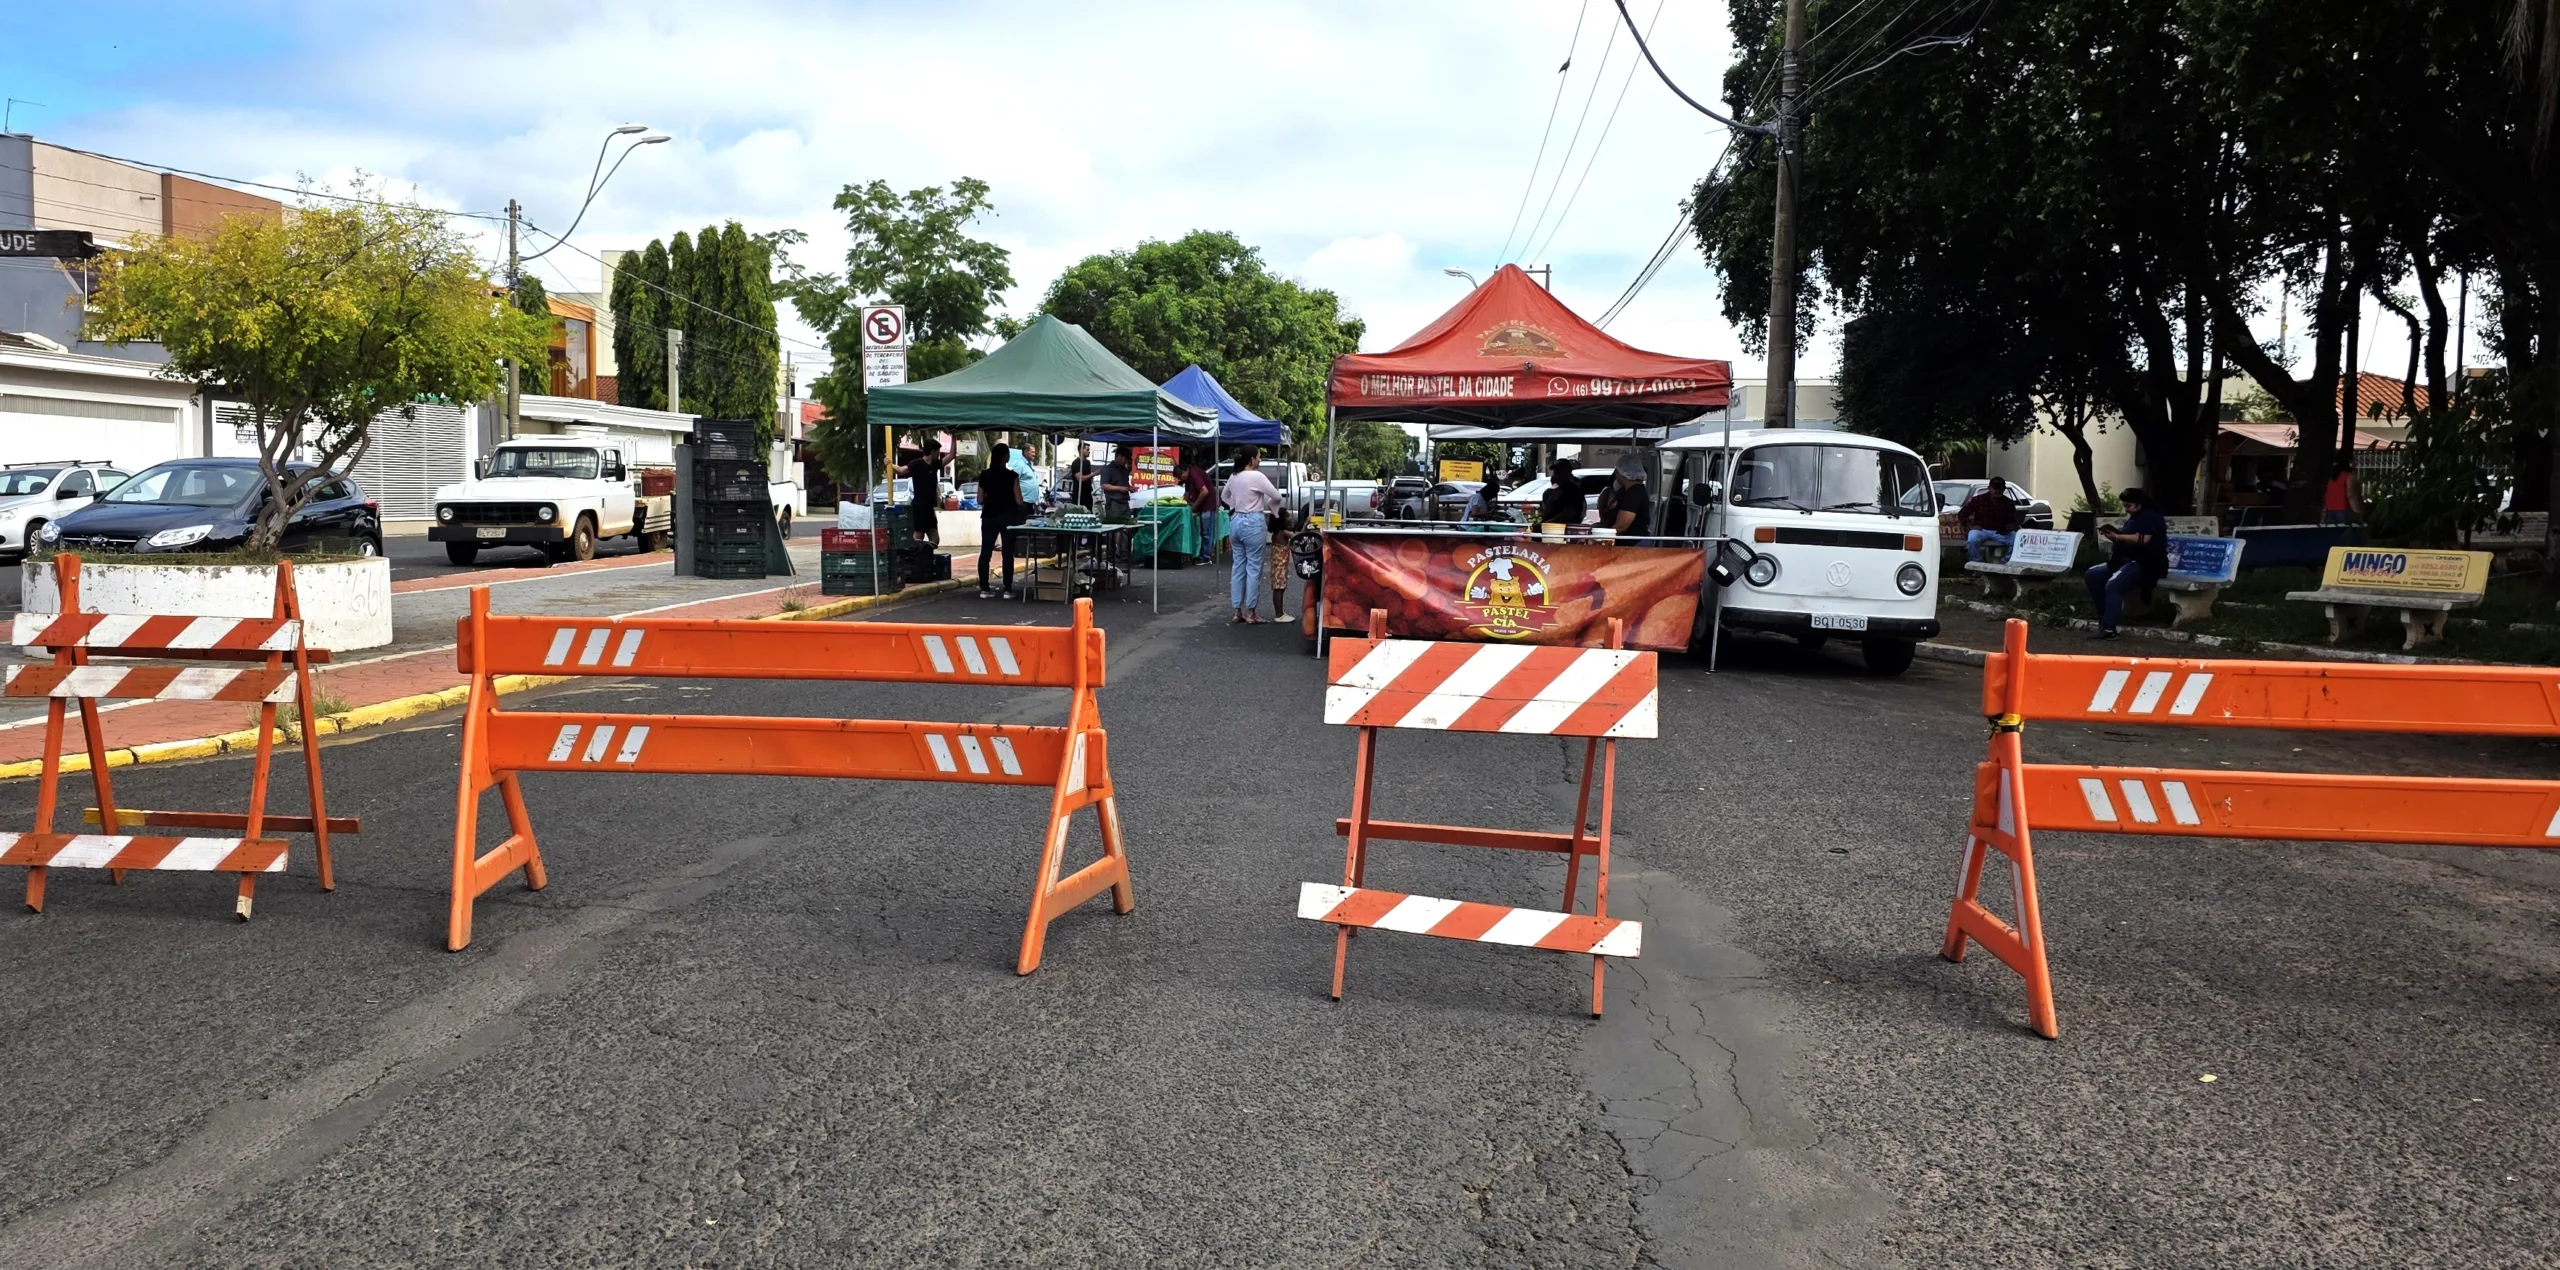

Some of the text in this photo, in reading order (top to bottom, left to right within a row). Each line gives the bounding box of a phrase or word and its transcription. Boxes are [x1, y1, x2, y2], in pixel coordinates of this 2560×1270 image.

[0, 233, 36, 251] UDE
[1360, 374, 1368, 396] O
[1371, 374, 1415, 396] MELHOR
[1417, 375, 1456, 397] PASTEL
[1458, 376, 1472, 397] DA
[1475, 376, 1515, 397] CIDADE
[1572, 384, 1589, 397] (16)
[1466, 545, 1551, 575] PASTELARIA
[2342, 552, 2406, 574] MINGO
[1482, 607, 1530, 620] PASTEL
[1492, 618, 1517, 627] CIA
